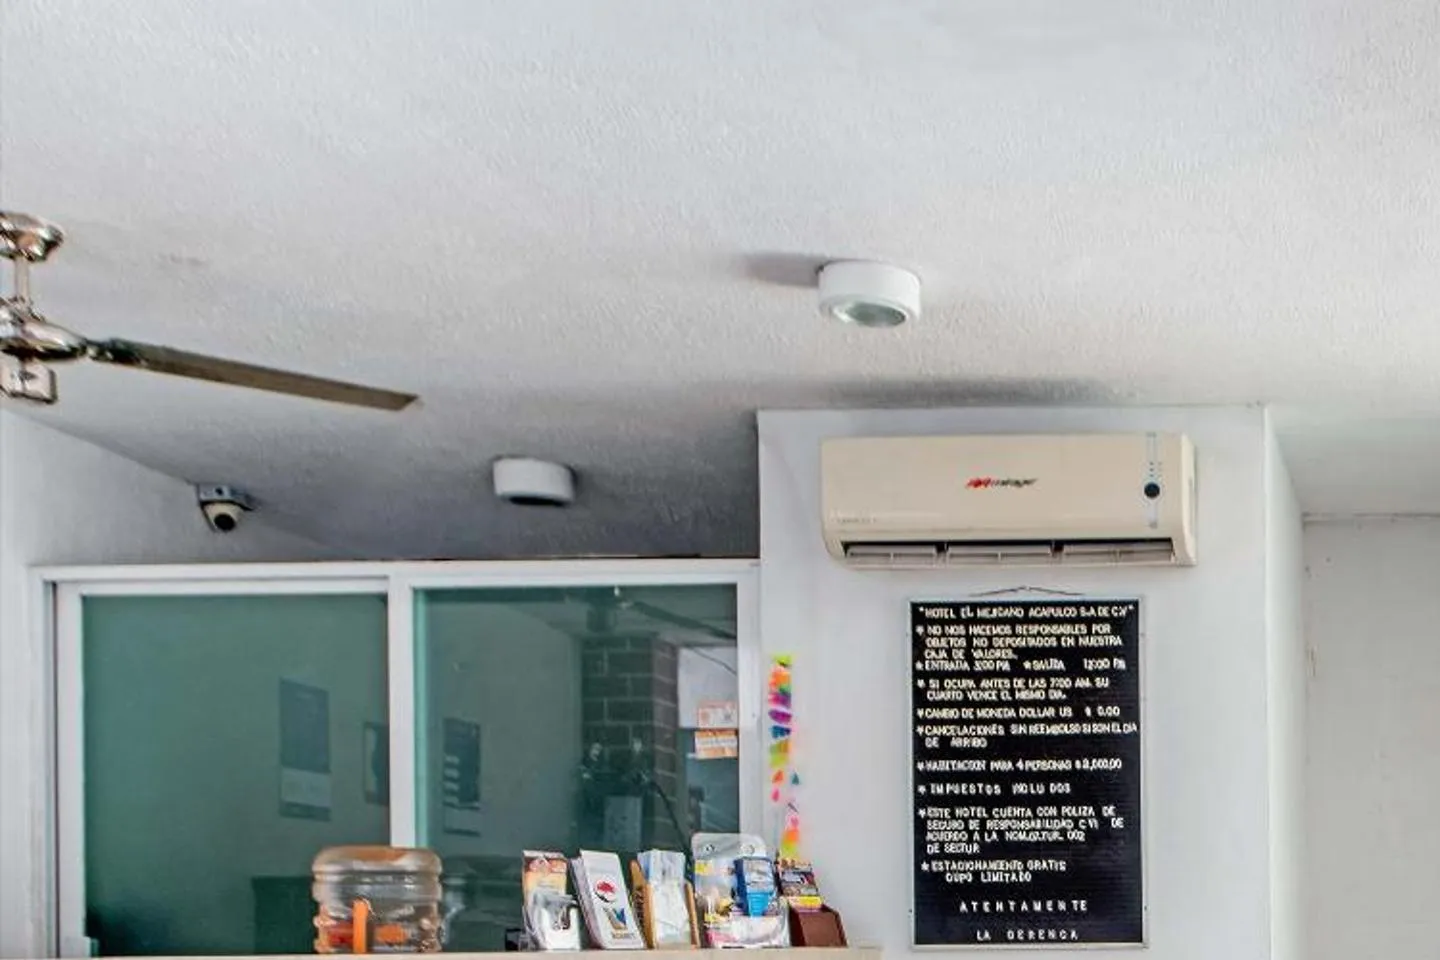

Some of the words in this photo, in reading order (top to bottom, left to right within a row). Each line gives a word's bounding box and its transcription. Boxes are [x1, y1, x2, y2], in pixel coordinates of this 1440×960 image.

[961, 605, 974, 619] EL
[1028, 606, 1078, 618] ACAPULCO
[1097, 606, 1110, 618] DE
[927, 624, 942, 636] NO
[944, 624, 966, 636] NOS
[969, 624, 1012, 636] HACEMOS
[1015, 623, 1088, 636] RESPONSABLES
[1092, 623, 1111, 635] POR
[925, 637, 967, 648] OBJETOS
[973, 637, 989, 648] NO
[992, 636, 1057, 648] DEPOSITADOS
[1061, 636, 1075, 648] EN
[1079, 635, 1123, 647] NUESTRA
[924, 648, 948, 660] CAJA
[952, 648, 965, 660] DE
[925, 660, 971, 671] ENTRADA
[1032, 658, 1067, 671] SALIDA
[928, 678, 940, 689] SI
[980, 678, 1010, 689] ANTES
[1013, 677, 1026, 689] DE
[1028, 677, 1047, 689] LAS
[1095, 677, 1109, 688] SU
[927, 690, 964, 701] CUARTO
[967, 690, 998, 701] VENCE
[1000, 690, 1013, 701] EL
[1015, 689, 1046, 701] MISMO
[925, 707, 960, 719] CAMBIO
[961, 707, 974, 719] DE
[976, 707, 1017, 719] MONEDA
[1019, 707, 1056, 718] DOLLAR
[1059, 706, 1073, 718] US
[925, 724, 1006, 736] CANCELACIONES
[1010, 723, 1028, 735] SIN
[1029, 723, 1081, 735] REEMBOLSO
[1081, 723, 1091, 735] SI
[1092, 723, 1110, 734] SON
[1111, 722, 1121, 734] EL
[1123, 722, 1138, 734] DIA
[925, 736, 939, 748] DE
[950, 736, 988, 748] ARRIBO
[925, 759, 986, 771] HABITACION
[990, 760, 1014, 771] PARA
[1015, 757, 1024, 771] 4
[1025, 759, 1072, 771] PERSONAS
[930, 783, 1002, 796] IMPUESTOS
[927, 807, 951, 819] ESTE
[955, 806, 989, 819] HOTEL
[992, 806, 1034, 819] CUENTA
[1036, 805, 1058, 817] CON
[1061, 805, 1096, 817] POLIZA
[1102, 805, 1116, 817] DE
[927, 819, 965, 831] SEGURO
[968, 819, 980, 831] DE
[986, 819, 1075, 831] RESPONSABILIDAD
[1111, 817, 1125, 829] DE
[926, 831, 969, 842] ACUERDO
[973, 831, 981, 841] A
[984, 831, 999, 842] LA
[926, 842, 940, 855] DE
[944, 842, 981, 854] SECTUR
[931, 860, 1024, 871] ESTACIONAMIENTO
[1026, 859, 1067, 871] GRATIS
[945, 871, 973, 883] CUPO
[980, 871, 1033, 882] LIMITADO
[976, 929, 992, 941] LA
